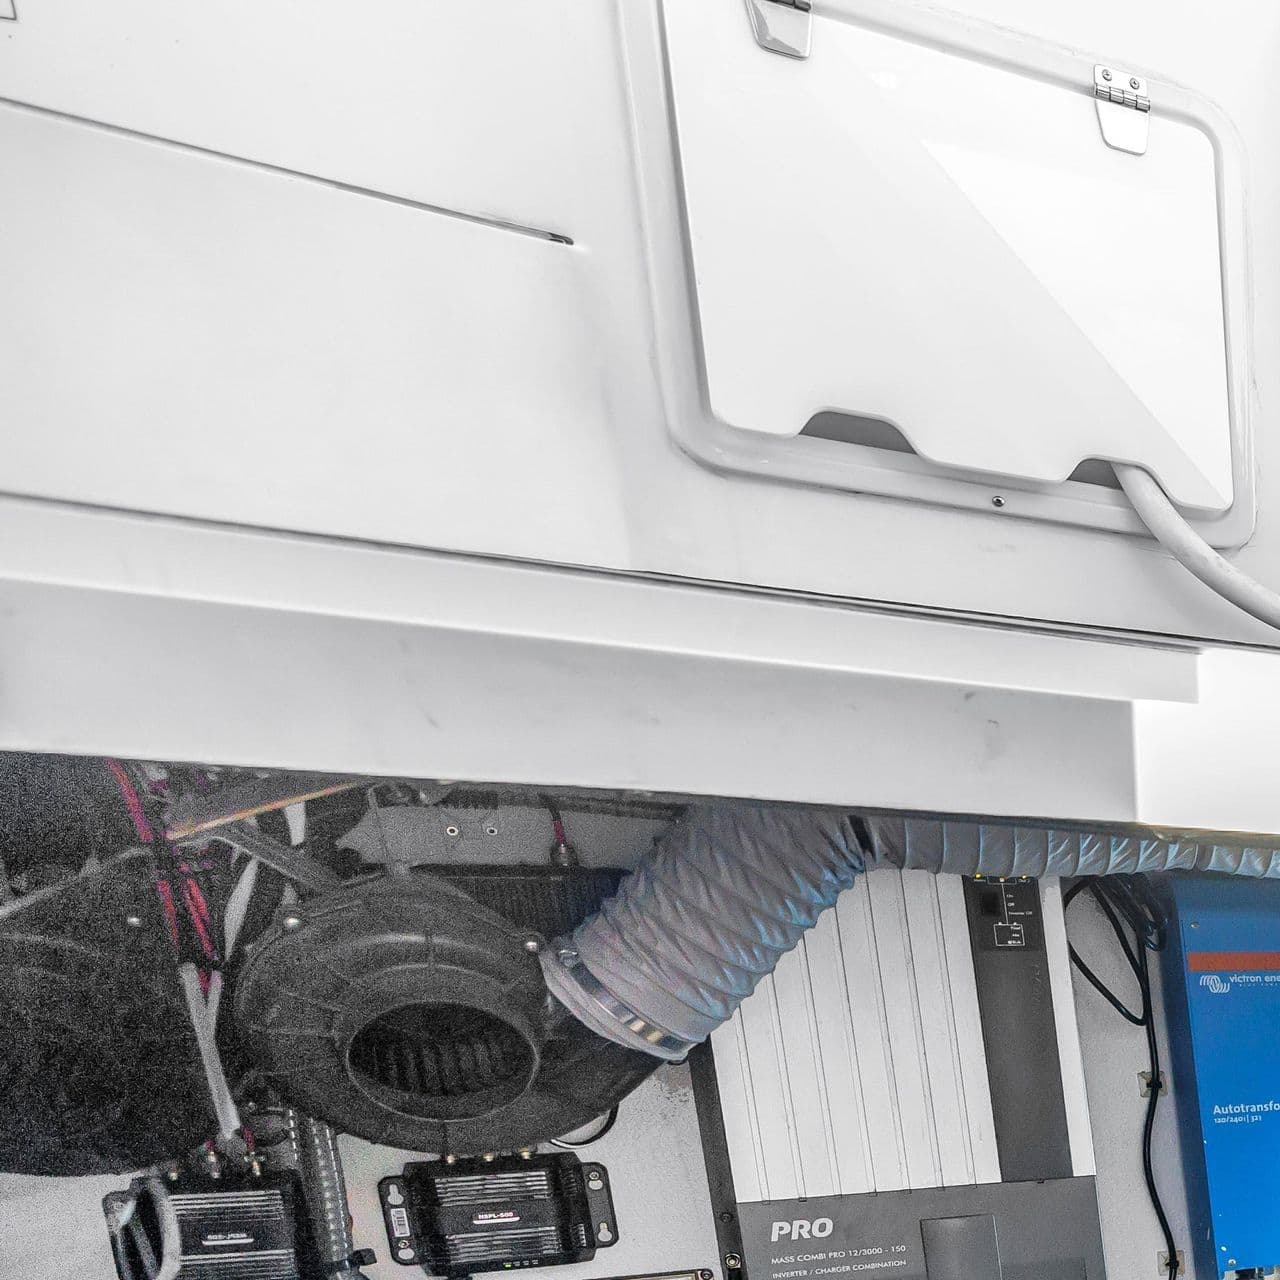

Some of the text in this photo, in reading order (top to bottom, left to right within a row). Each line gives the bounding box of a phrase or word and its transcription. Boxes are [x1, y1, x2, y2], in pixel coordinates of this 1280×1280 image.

[1229, 974, 1262, 983] victron
[771, 1217, 834, 1242] PRO
[771, 1255, 795, 1265] MASS
[797, 1252, 826, 1262] COMBI
[829, 1251, 846, 1259] PRO
[848, 1247, 883, 1257] 12/3000
[891, 1245, 906, 1253] 150
[772, 1269, 808, 1280] INVERTER
[815, 1265, 851, 1275] CHARGER
[852, 1259, 907, 1271] COMBINATION
